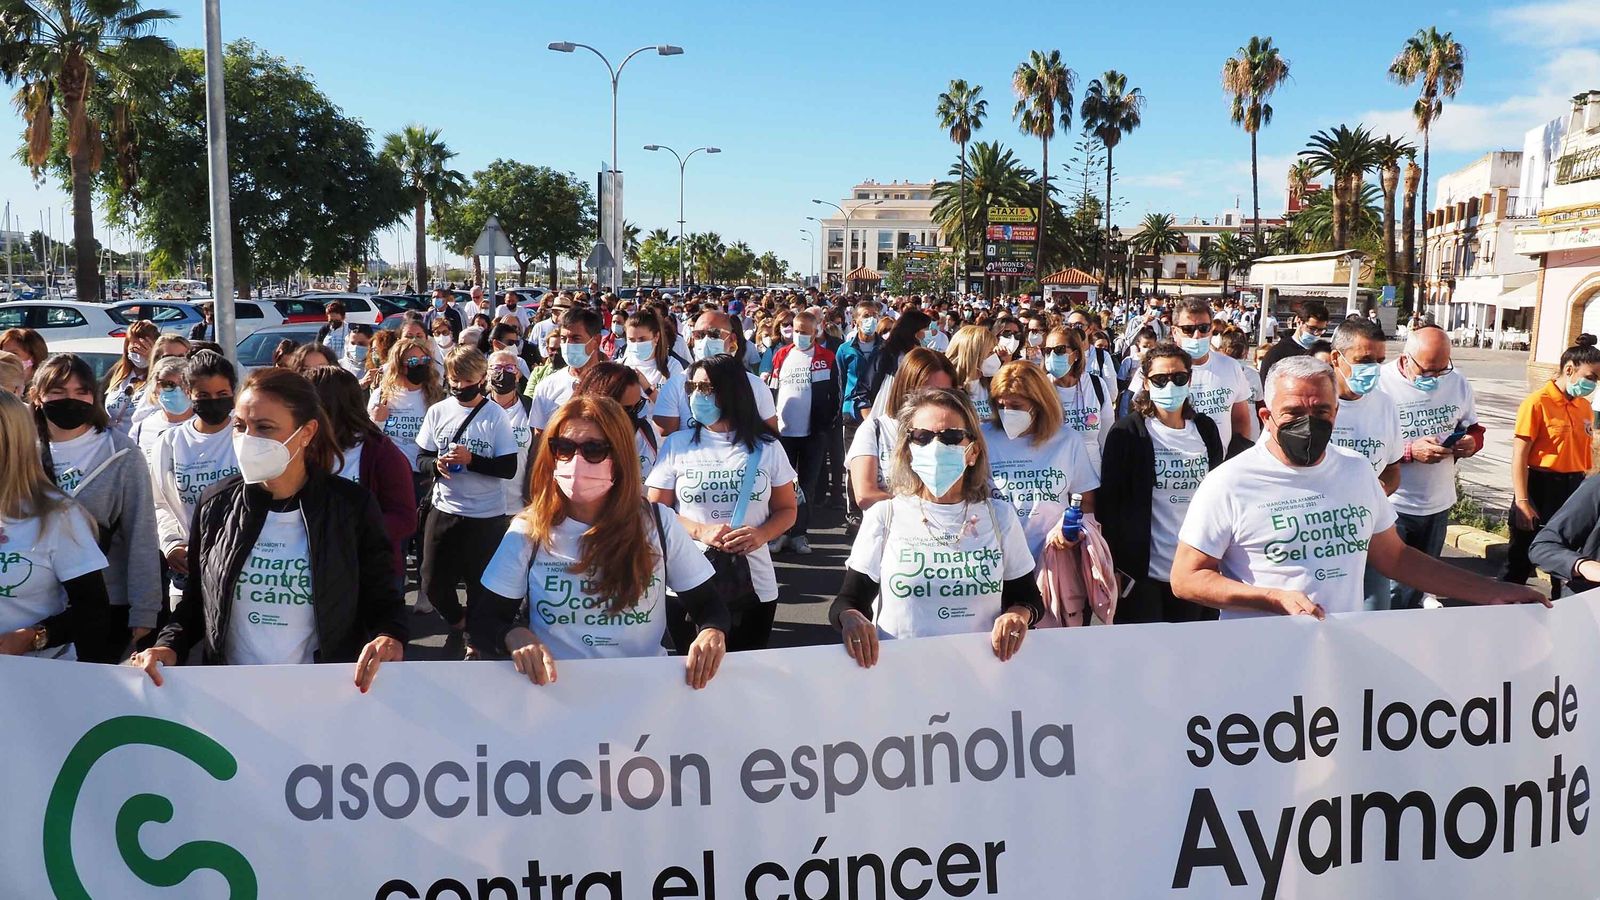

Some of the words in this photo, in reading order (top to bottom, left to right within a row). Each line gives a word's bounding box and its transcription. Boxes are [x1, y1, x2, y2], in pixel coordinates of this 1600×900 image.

[1400, 410, 1414, 422] En
[1417, 404, 1457, 417] marcha
[1413, 415, 1450, 427] contra
[1410, 428, 1420, 438] el
[1338, 437, 1381, 448] marcha
[196, 466, 239, 481] march
[1014, 467, 1063, 479] marcha
[1165, 467, 1206, 478] contra
[701, 479, 745, 491] contr
[1008, 479, 1053, 490] contra
[1156, 479, 1168, 490] el
[1173, 479, 1200, 490] cán
[694, 492, 706, 503] el
[1272, 514, 1299, 534] En
[1304, 504, 1368, 525] marcha
[1300, 521, 1358, 543] contra
[900, 549, 925, 568] En
[934, 546, 1001, 563] marcha
[1290, 545, 1307, 561] el
[250, 556, 311, 570] marc
[924, 562, 991, 580] contra
[238, 570, 311, 588] contra
[545, 575, 572, 598] En
[250, 588, 315, 605] cánc
[914, 582, 931, 598] el
[558, 612, 576, 625] el
[1186, 696, 1340, 768] sede
[1363, 682, 1512, 752] local
[1532, 675, 1578, 739] de
[285, 734, 712, 822] asociación
[741, 711, 1076, 815] española
[1172, 754, 1591, 900] Ayamonte
[652, 850, 716, 900] el
[744, 836, 1006, 900] cáncer
